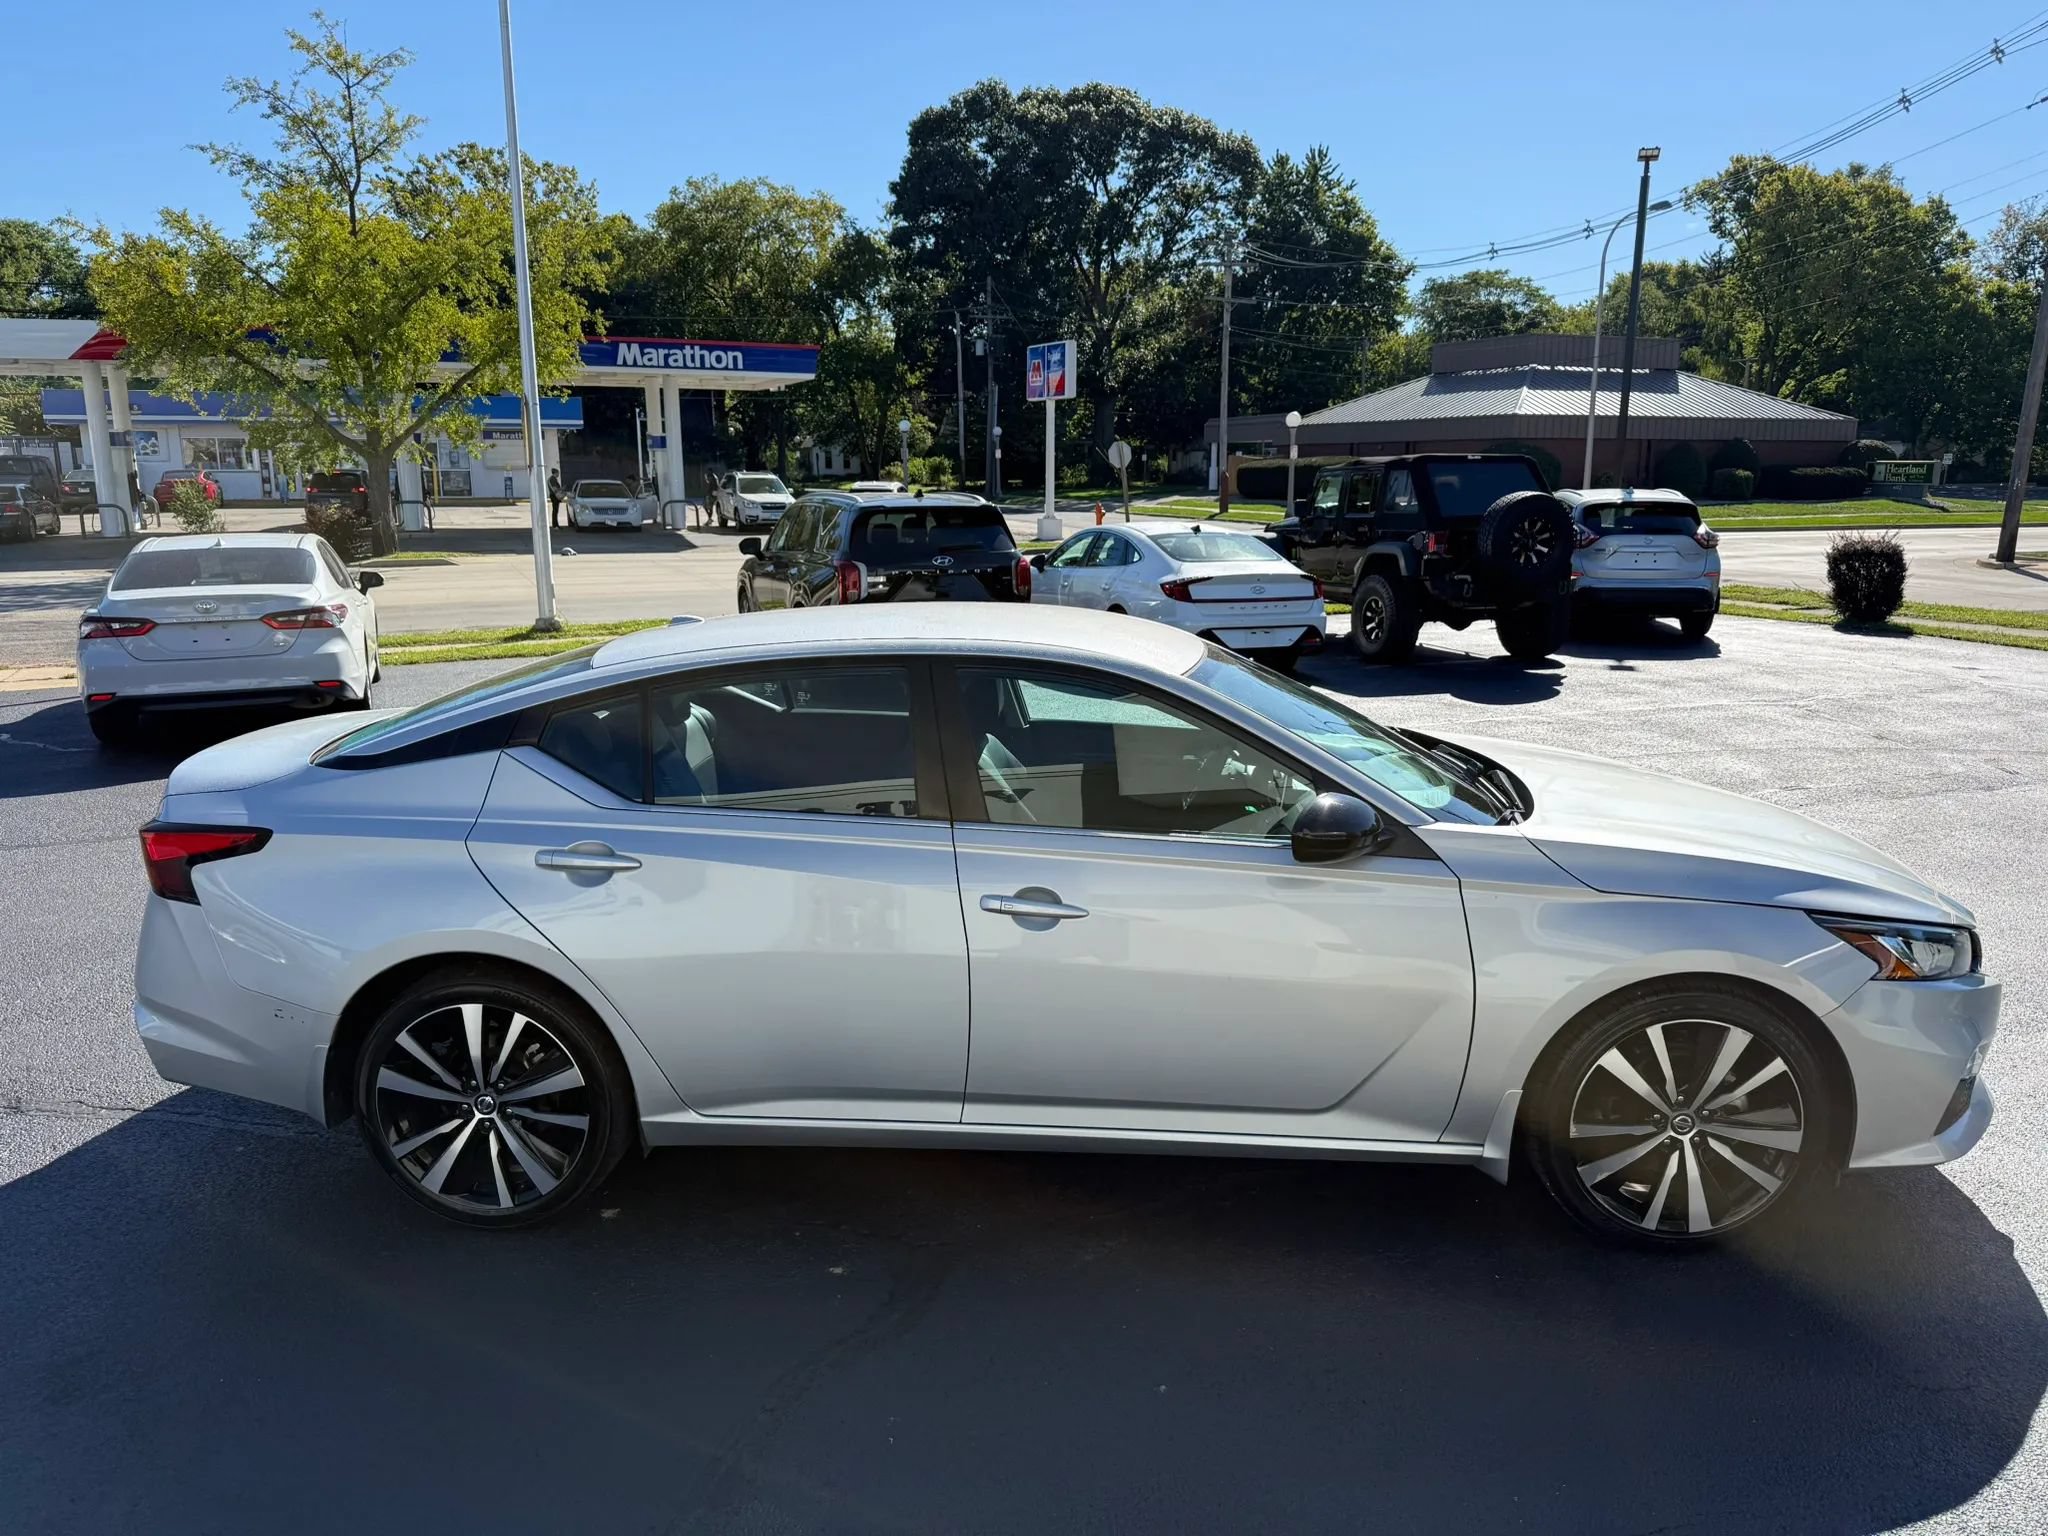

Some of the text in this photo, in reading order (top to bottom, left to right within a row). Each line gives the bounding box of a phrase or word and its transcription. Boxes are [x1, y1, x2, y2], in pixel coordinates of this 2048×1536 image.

[616, 343, 743, 369] Marathon
[492, 431, 524, 440] Marath
[1886, 464, 1927, 474] Heartland
[1885, 473, 1906, 482] Bank
